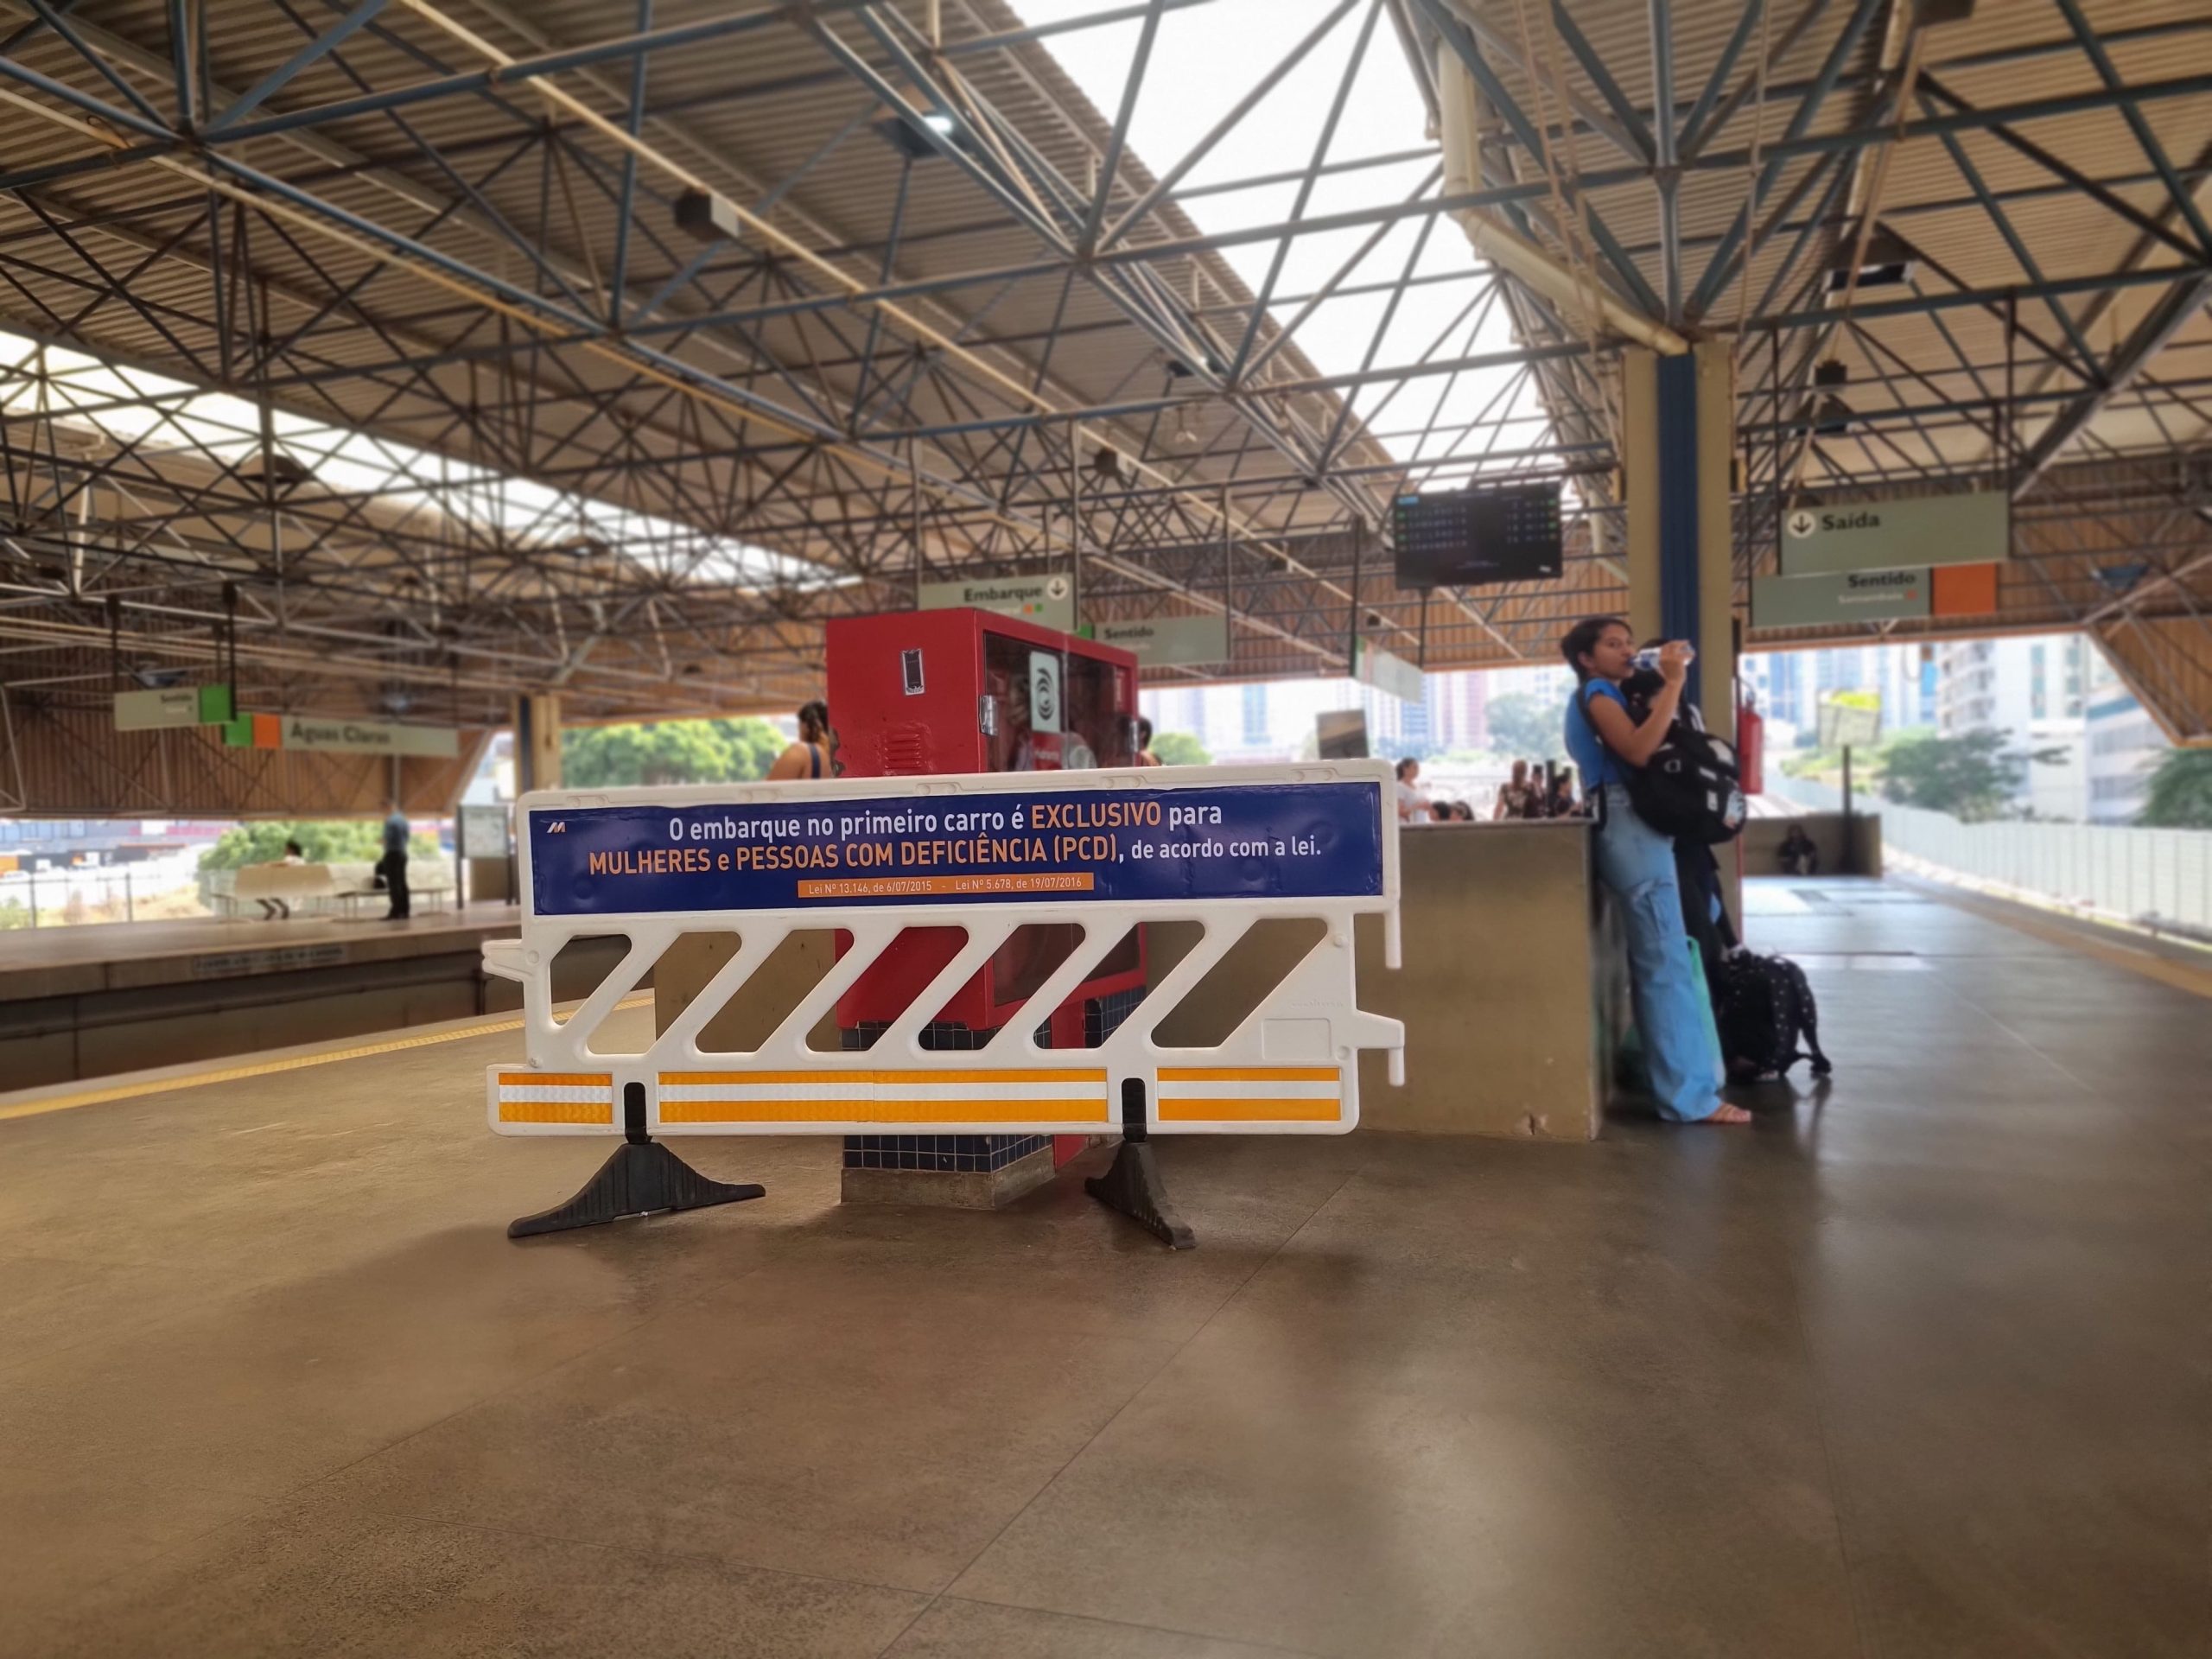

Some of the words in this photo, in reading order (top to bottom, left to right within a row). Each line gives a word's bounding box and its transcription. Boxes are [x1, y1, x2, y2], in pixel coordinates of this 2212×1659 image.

[1821, 512, 1881, 531] Saída
[1847, 571, 1917, 588] Sentido
[963, 587, 1043, 602] Embarque
[1103, 626, 1155, 639] Sentido
[670, 817, 683, 841] O
[690, 815, 800, 843] embarque
[807, 817, 834, 837] no
[841, 808, 938, 842] primeiro
[944, 812, 1004, 832] carro
[1011, 804, 1024, 830] é
[1032, 801, 1161, 830] EXCLUSIVO
[1169, 804, 1222, 831] para
[589, 849, 711, 875] MULHERES
[717, 854, 729, 871] e
[737, 843, 839, 870] PESSOAS
[846, 842, 893, 867] COM
[901, 832, 1048, 865] DEFICIÊNCIA
[1054, 834, 1124, 864] (PCD),
[1131, 839, 1154, 859] de
[1159, 837, 1224, 859] acordo
[1229, 841, 1269, 857] com
[1274, 841, 1286, 856] a
[1292, 835, 1322, 855] lei.
[809, 884, 823, 894] Lei
[824, 883, 836, 893] Nº
[839, 882, 871, 894] 13.146,
[873, 883, 884, 893] de
[886, 880, 932, 893] 6/07/2015
[955, 880, 970, 891] Lei
[972, 880, 984, 890] Nº
[986, 878, 1014, 891] 5.678,
[1015, 878, 1027, 889] de
[1031, 876, 1082, 888] 19/07/2016
